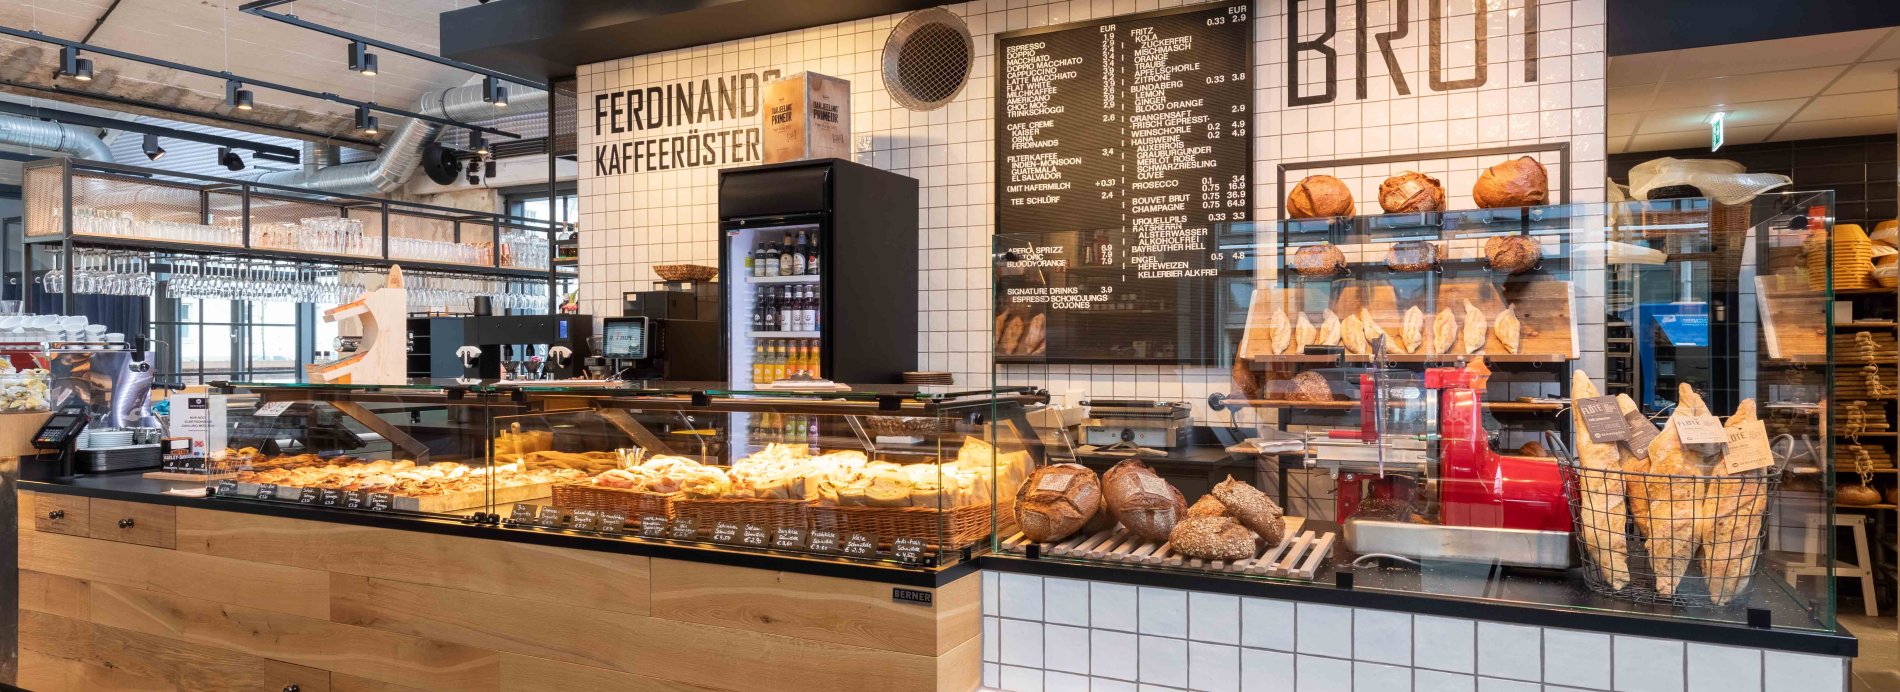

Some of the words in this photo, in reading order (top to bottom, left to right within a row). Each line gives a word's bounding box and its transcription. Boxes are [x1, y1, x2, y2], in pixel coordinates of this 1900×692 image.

[1228, 5, 1247, 14] EUR
[1100, 24, 1116, 32] EUR
[1131, 27, 1153, 36] FRITZ
[1207, 17, 1225, 26] 0.33
[1232, 14, 1246, 22] 2.9
[1136, 34, 1157, 43] KOLA
[1141, 36, 1192, 49] ZUCKERFREI
[1007, 42, 1045, 53] ESPRESSO
[1135, 43, 1191, 56] MISCHMASCH
[1007, 50, 1035, 59] DOPPIO
[1134, 53, 1168, 63] ORANGE
[1007, 55, 1050, 66] MACCHIATO
[1007, 63, 1034, 73] DOPPIO
[1037, 57, 1083, 68] MACCHIATO
[1135, 60, 1165, 70] TRAUBE
[1007, 68, 1056, 79] CAPPUCCINO
[1135, 63, 1200, 77] APFELSCHORLE
[1032, 71, 1076, 82] MACCHIATO
[1135, 74, 1170, 84] ZITRONE
[1007, 83, 1023, 91] FLAT
[1027, 81, 1050, 90] WHITE
[1131, 81, 1183, 92] BUNDABERG
[1206, 75, 1224, 84] 0.33
[1232, 73, 1245, 81] 3.8
[1007, 87, 1057, 98] MILCHKAFFEE
[1136, 90, 1165, 99] LEMON
[1007, 94, 1050, 105] AMERICANO
[1135, 96, 1166, 105] GINGER
[1007, 103, 1027, 111] CHOC
[1136, 102, 1164, 113] BLOOD
[1167, 100, 1203, 109] ORANGE
[813, 109, 838, 123] PRIMEUR
[1007, 106, 1064, 118] TRINKSCHOGGI
[1130, 110, 1192, 123] ORANGENSAFT
[1232, 105, 1245, 113] 2.9
[771, 112, 792, 125] PRIMEUR
[1029, 120, 1054, 128] CREME
[1131, 126, 1191, 137] WEINSCHORLE
[1208, 123, 1220, 131] 0.2
[1131, 135, 1180, 146] HAUSWEINE
[1208, 131, 1220, 139] 0.2
[1012, 140, 1058, 150] FERDINANDS
[1137, 142, 1184, 152] AUXERROIS
[1137, 146, 1211, 159] GRAUBURGUNDER
[1007, 153, 1057, 163] FILTERKAFFEE
[1012, 158, 1081, 168] INDIEN-MONSOON
[1137, 157, 1168, 166] MERLOT
[1012, 166, 1056, 175] GUATEMALA
[1137, 160, 1216, 172] SCHWARZRIESLING
[1138, 172, 1164, 180] CUVEE
[1024, 183, 1070, 191] HAFERMILCH
[1132, 180, 1178, 189] PROSECCO
[1232, 175, 1245, 183] 3.4
[1202, 184, 1220, 192] 0.75
[1132, 196, 1166, 205] BOUVET
[1169, 194, 1190, 202] BRUT
[1227, 191, 1245, 199] 36.9
[1132, 203, 1185, 213] CHAMPAGNE
[1203, 201, 1220, 209] 0.75
[1227, 199, 1245, 207] 64.9
[1133, 216, 1187, 225] URQUELLPILS
[1233, 212, 1245, 220] 3.3
[1133, 223, 1182, 232] RATSHERRN
[1139, 229, 1207, 239] ALSTERWASSER
[1139, 236, 1199, 246] ALKOHOLFREI
[1132, 245, 1183, 253] BAYREUTHER
[1131, 256, 1158, 264] ENGEL
[1138, 262, 1189, 270] HEFEWEIZEN
[1138, 270, 1182, 278] KELLERBIER
[894, 590, 931, 602] BERNER
